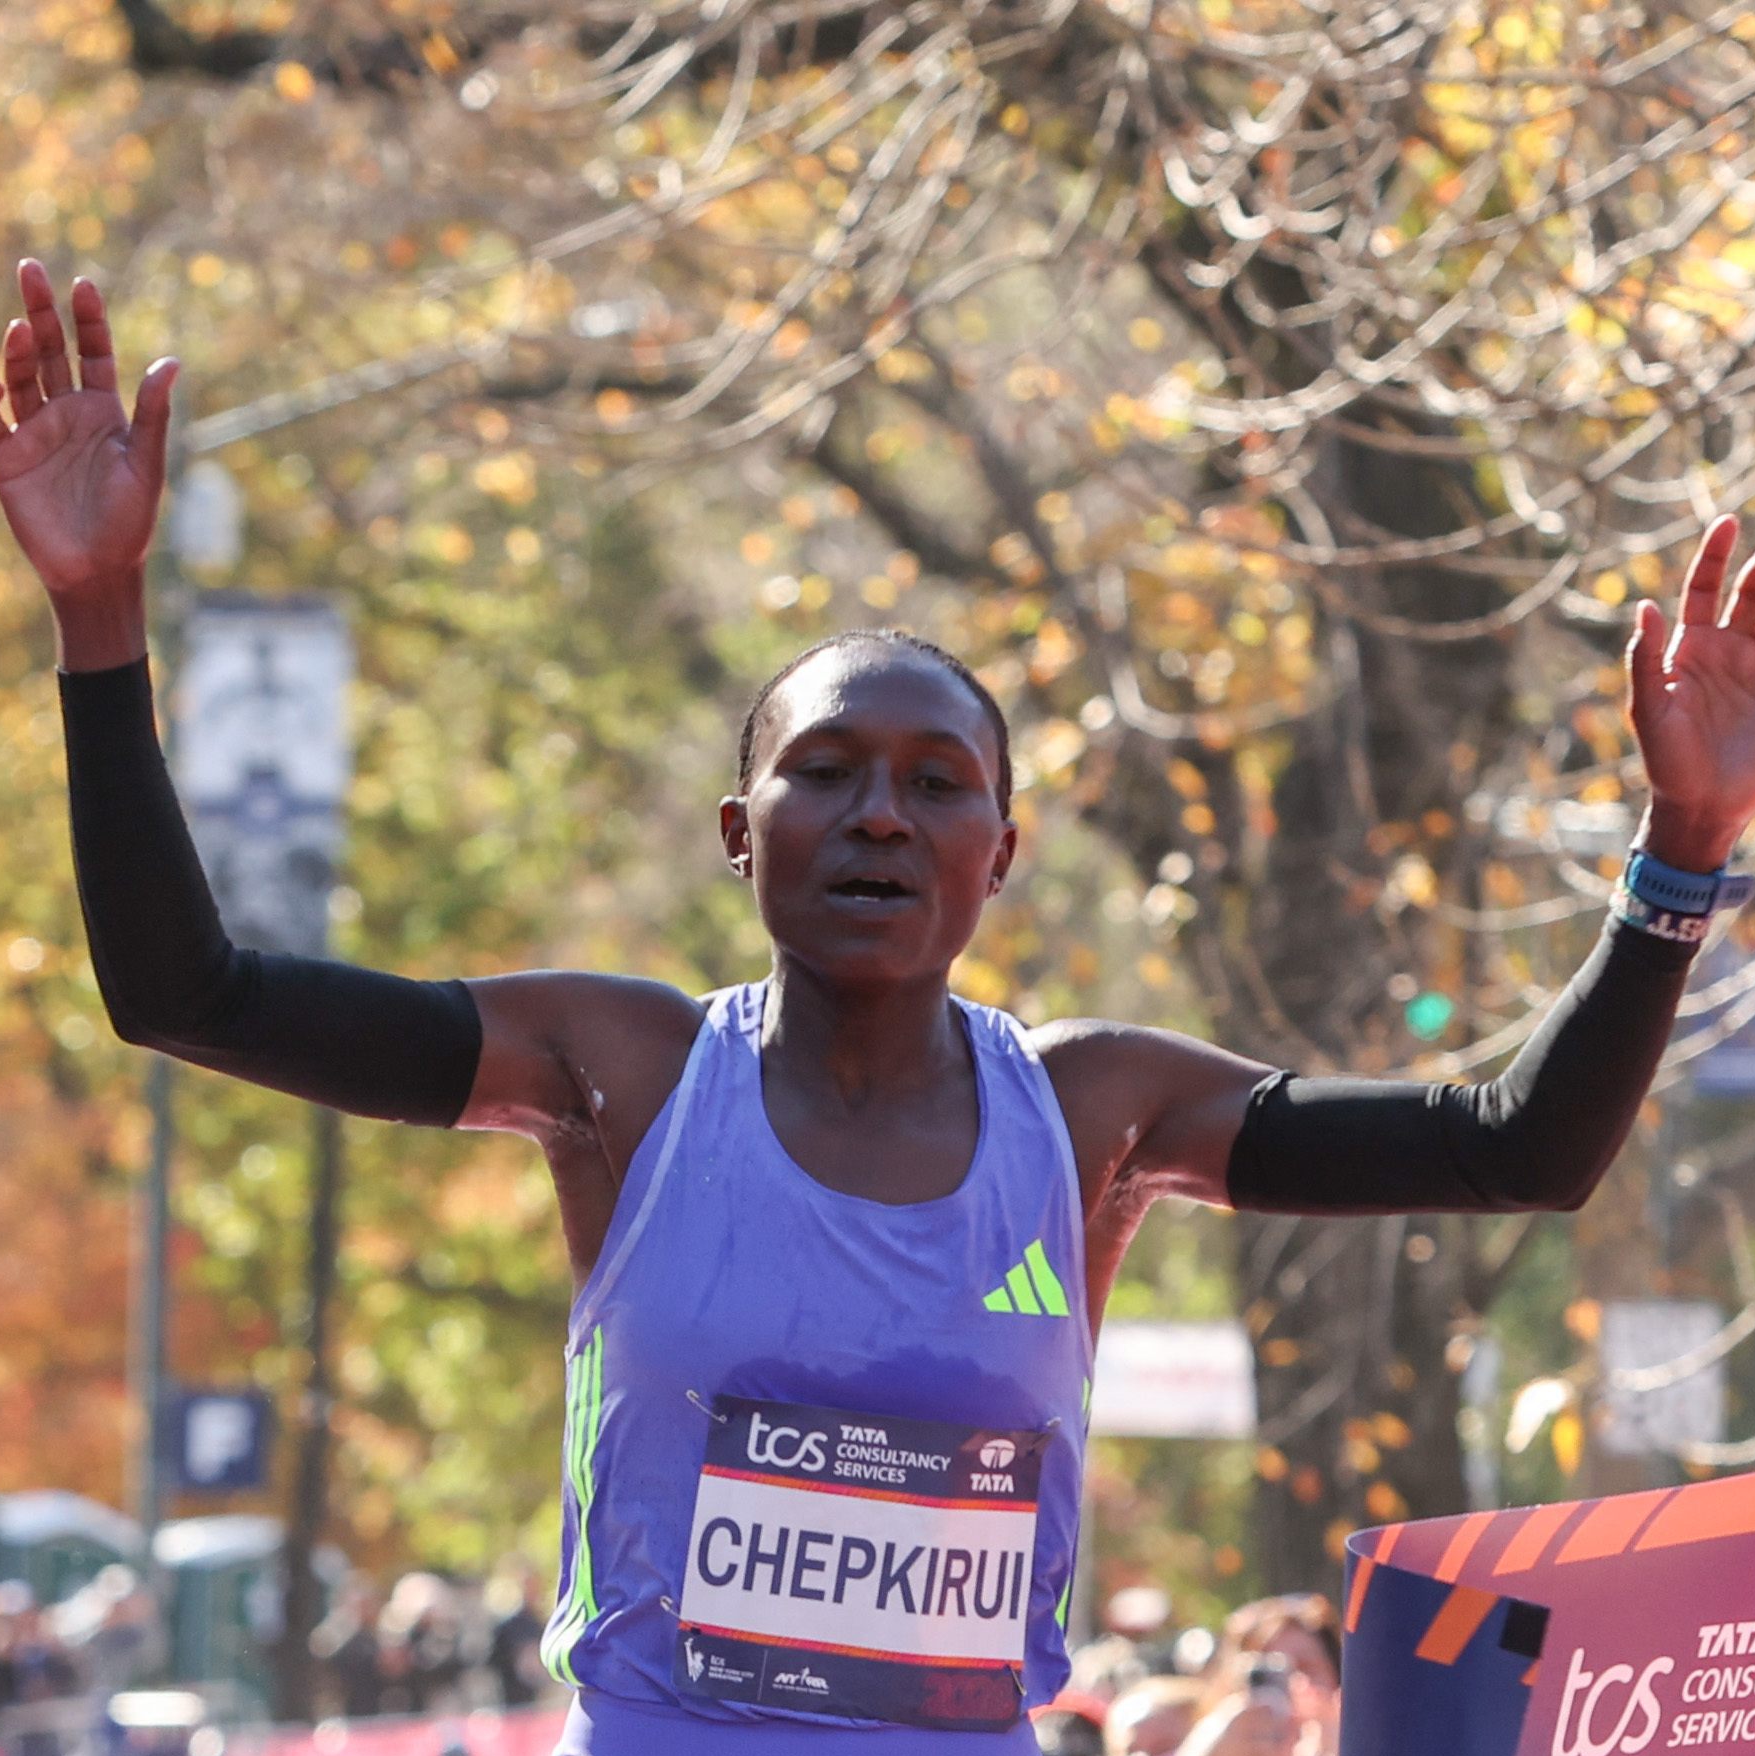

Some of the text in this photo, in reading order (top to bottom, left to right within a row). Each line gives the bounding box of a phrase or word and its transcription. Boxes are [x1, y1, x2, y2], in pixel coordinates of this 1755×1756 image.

[747, 1412, 828, 1472] tcs
[840, 1424, 888, 1446] TATA
[836, 1443, 951, 1472] CONSULTANCY
[833, 1461, 906, 1484] SERVICES
[970, 1473, 1014, 1493] TATA
[697, 1516, 1025, 1620] CHEPKIRUI
